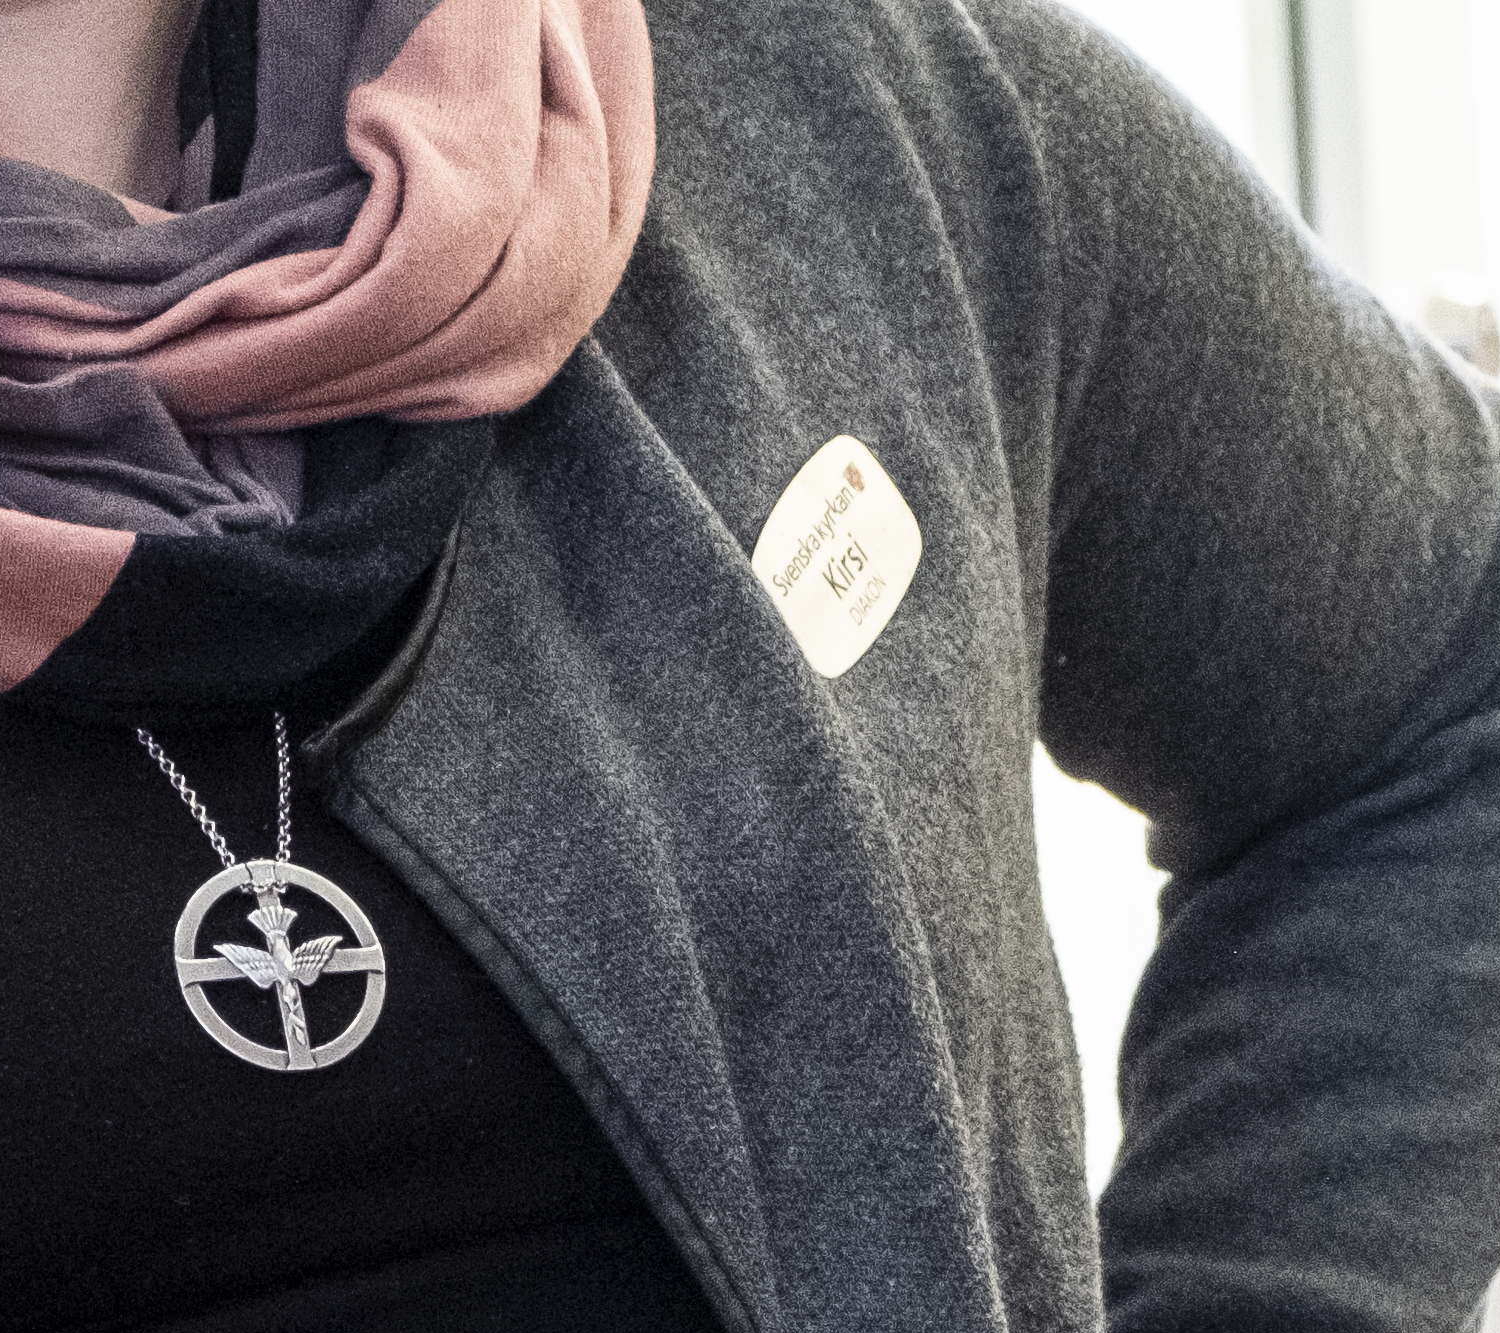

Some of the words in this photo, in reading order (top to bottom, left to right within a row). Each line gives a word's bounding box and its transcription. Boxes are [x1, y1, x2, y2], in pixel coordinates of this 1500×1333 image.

[772, 535, 820, 597] Svenska
[813, 486, 853, 540] kyrkan
[822, 532, 868, 600] Kirsi
[849, 573, 886, 625] DIAKON
